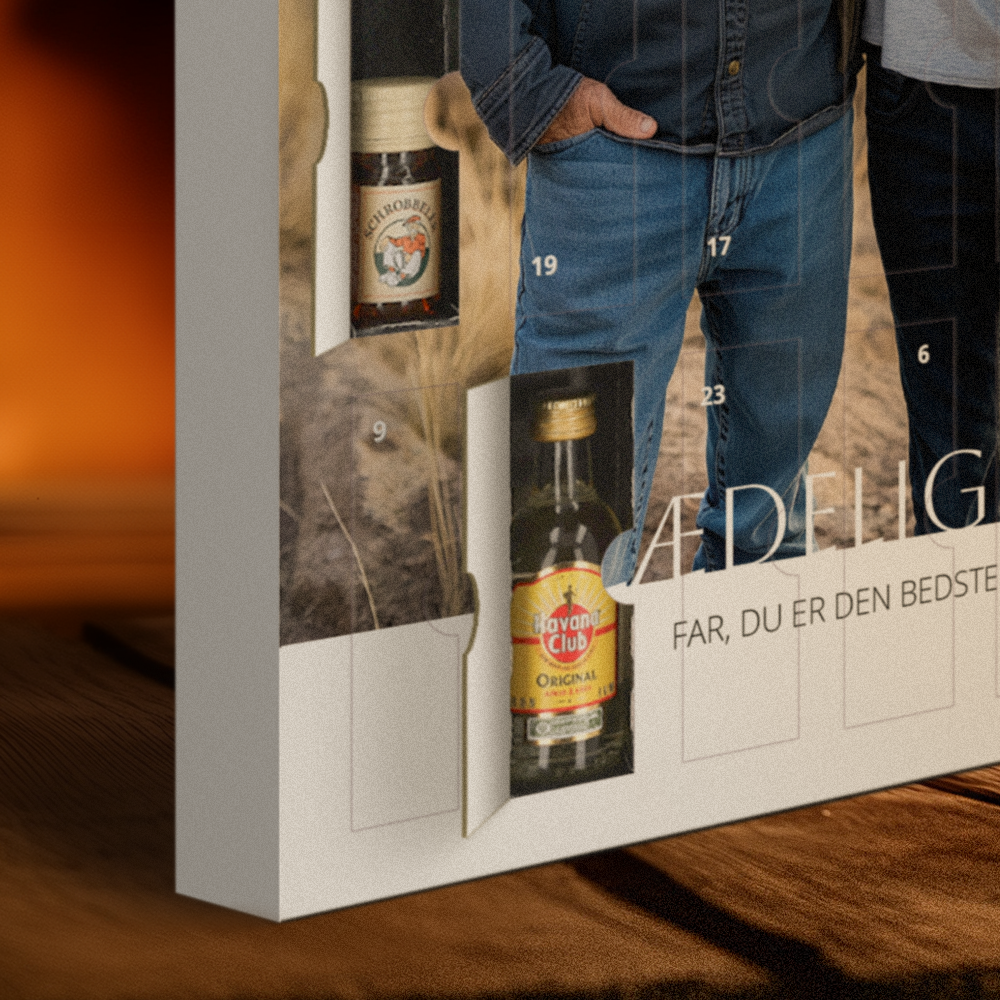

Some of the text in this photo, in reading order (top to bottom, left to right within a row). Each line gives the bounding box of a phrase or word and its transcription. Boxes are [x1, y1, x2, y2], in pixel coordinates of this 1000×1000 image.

[707, 235, 731, 257] 17
[532, 254, 558, 276] 19
[917, 344, 930, 364] 6
[702, 384, 725, 405] 23
[373, 421, 387, 442] 9
[672, 563, 999, 650] FAR, DU ER DEN BEDSTE
[533, 609, 600, 633] Havana
[548, 631, 588, 654] Club
